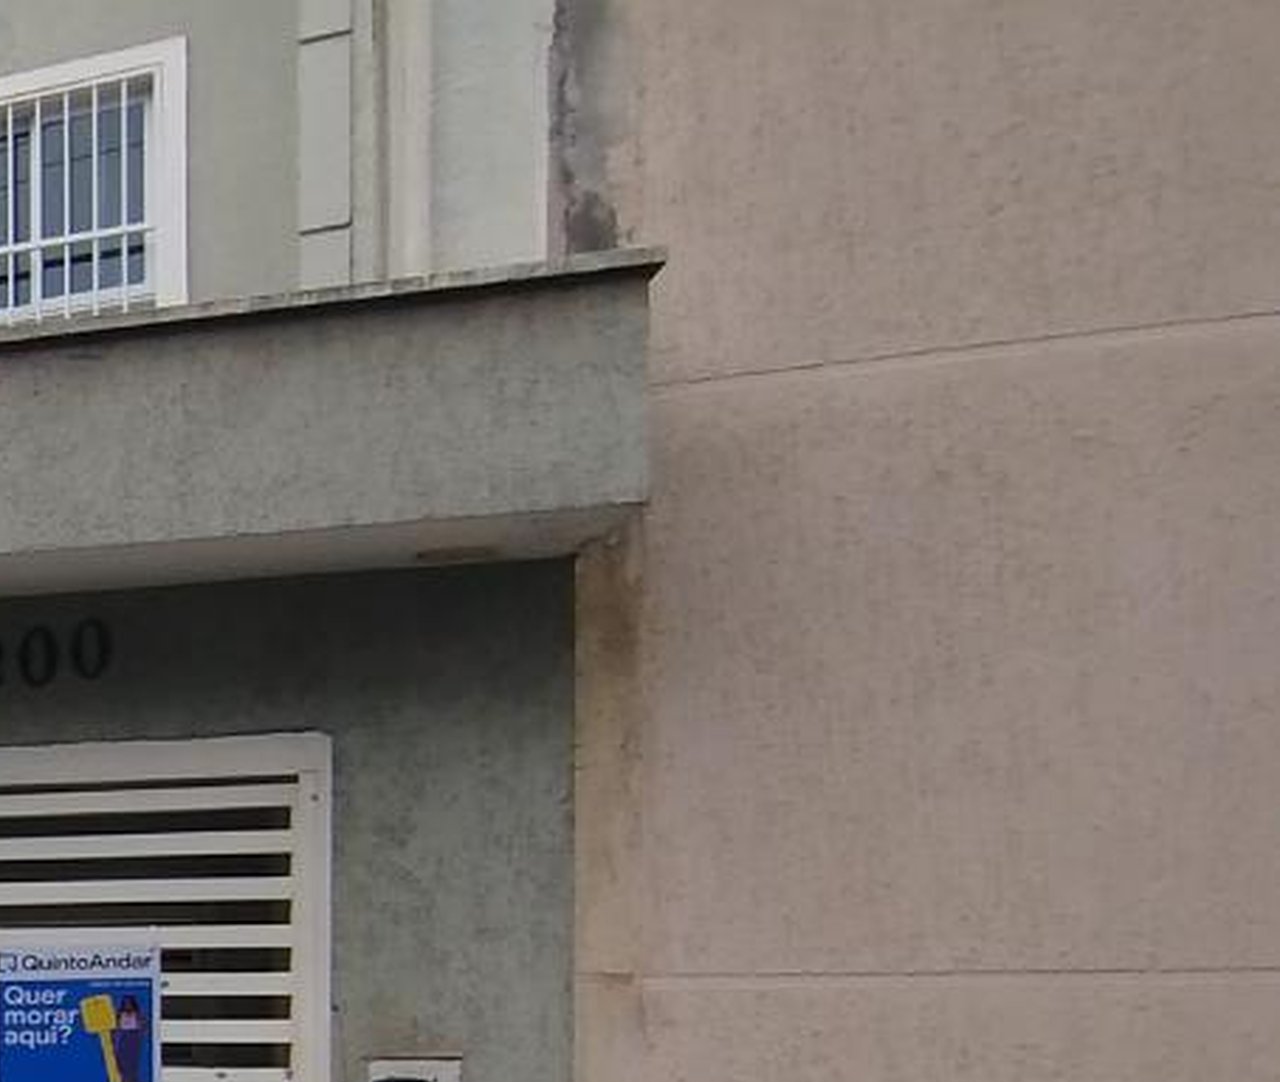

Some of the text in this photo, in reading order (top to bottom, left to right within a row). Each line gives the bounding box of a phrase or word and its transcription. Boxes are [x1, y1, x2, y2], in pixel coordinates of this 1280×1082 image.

[22, 953, 153, 971] QuintoAndar
[4, 985, 67, 1006] Quer
[4, 1008, 78, 1025] morar
[4, 1025, 72, 1049] aqui?
